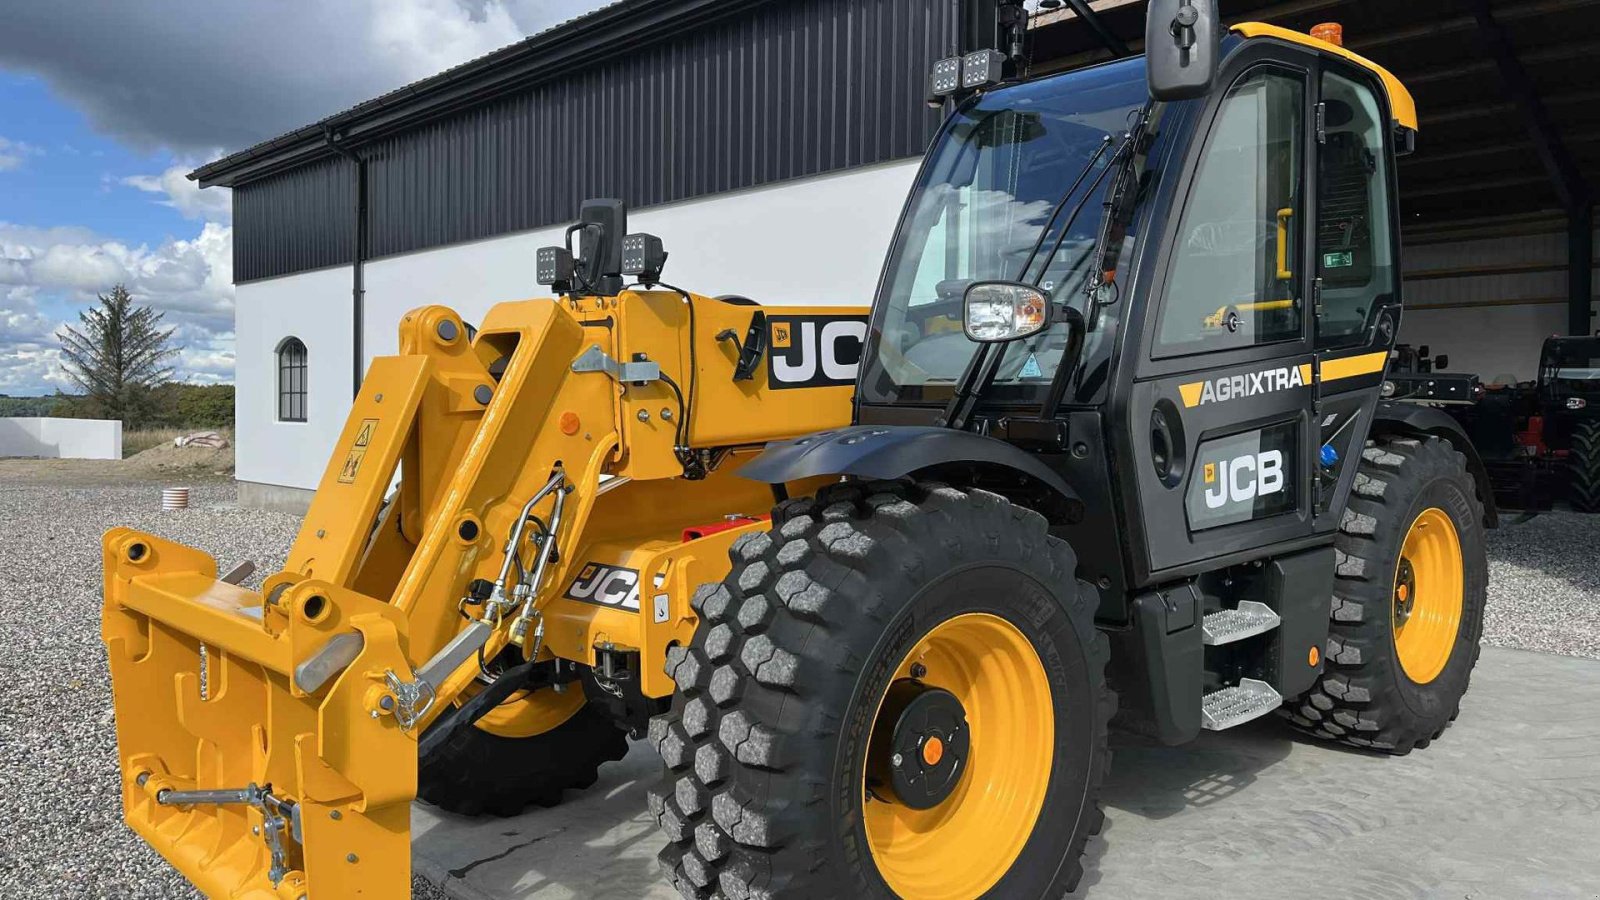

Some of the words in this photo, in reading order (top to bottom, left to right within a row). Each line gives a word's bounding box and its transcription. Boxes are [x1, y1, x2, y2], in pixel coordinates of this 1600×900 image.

[772, 320, 868, 383] JC
[1200, 365, 1303, 406] AGRIXTRA
[1205, 449, 1284, 509] JCB
